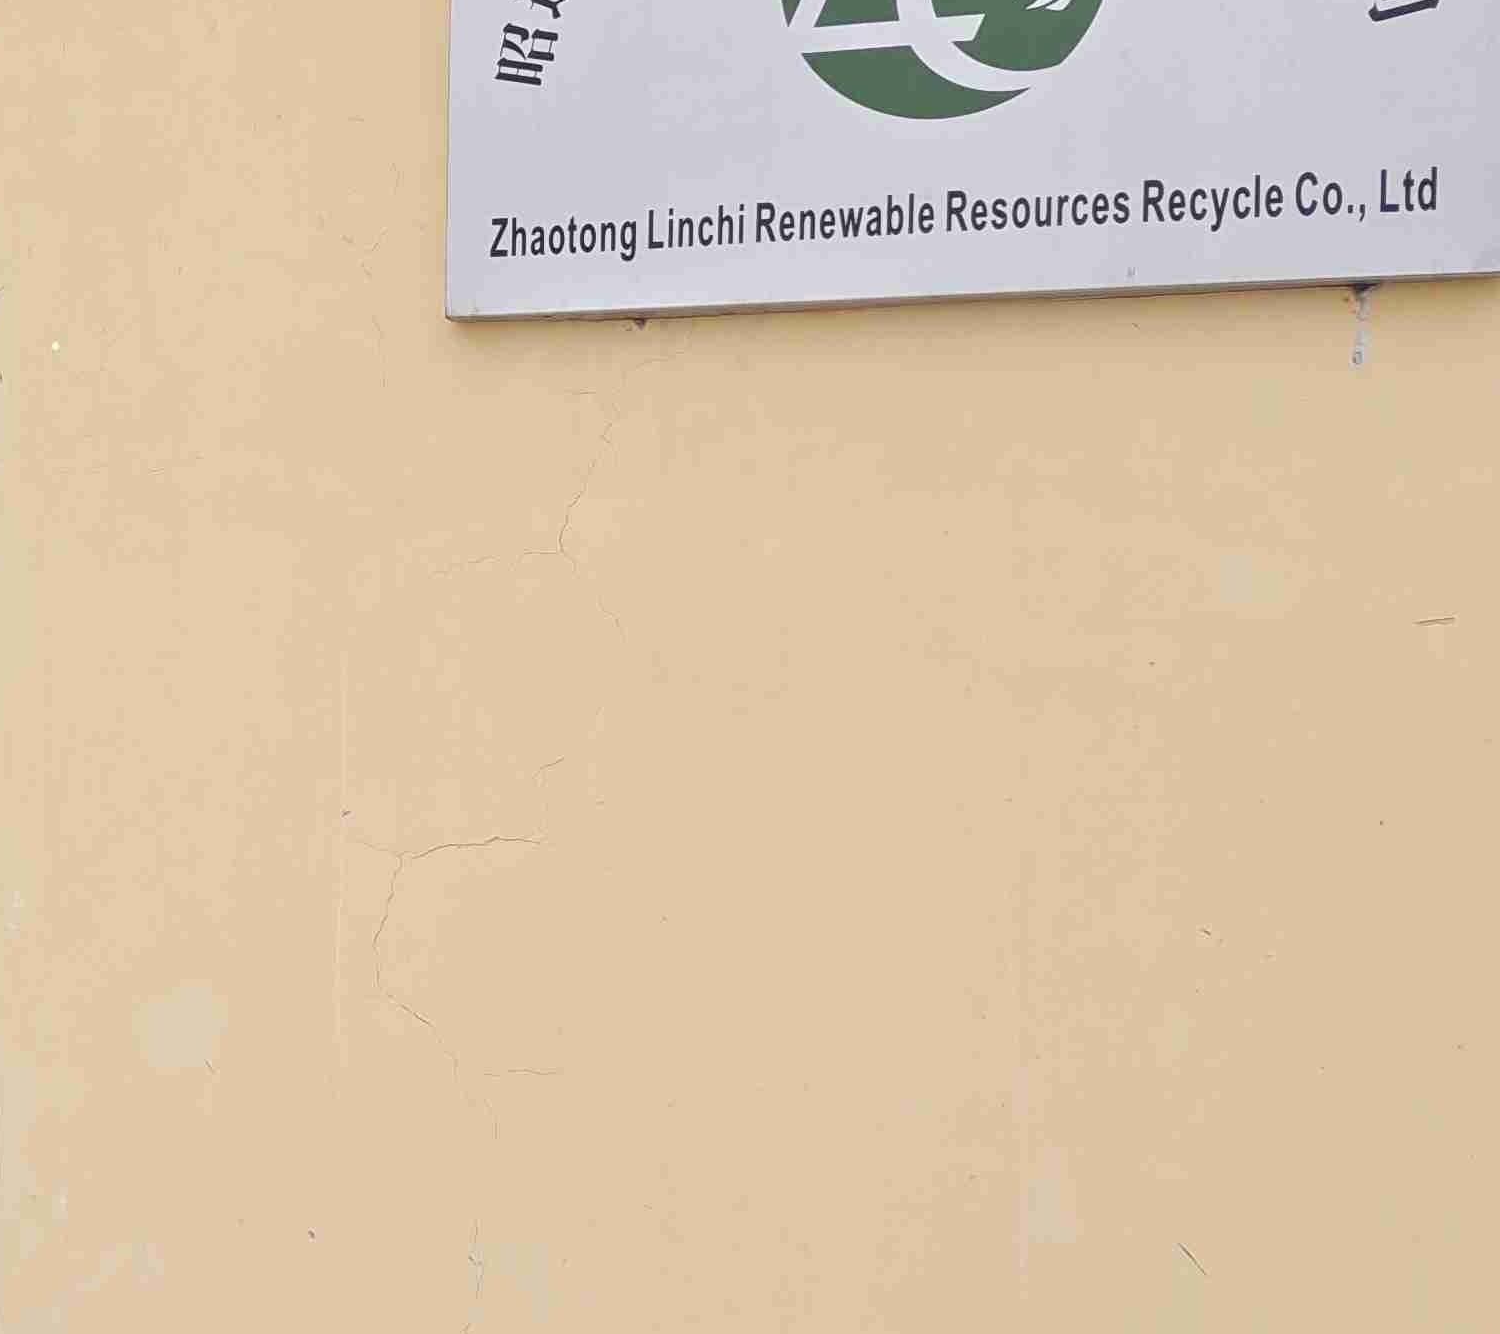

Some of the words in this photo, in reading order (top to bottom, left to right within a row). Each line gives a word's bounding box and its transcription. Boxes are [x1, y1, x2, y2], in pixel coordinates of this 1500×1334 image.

[490, 216, 637, 262] Zhaotong
[647, 203, 745, 249] Linchi
[755, 193, 935, 243] Renewable
[946, 190, 1130, 232] Resources
[1142, 174, 1284, 232] Recycle
[1295, 171, 1366, 222] Co.,
[1379, 166, 1438, 213] Ltd
